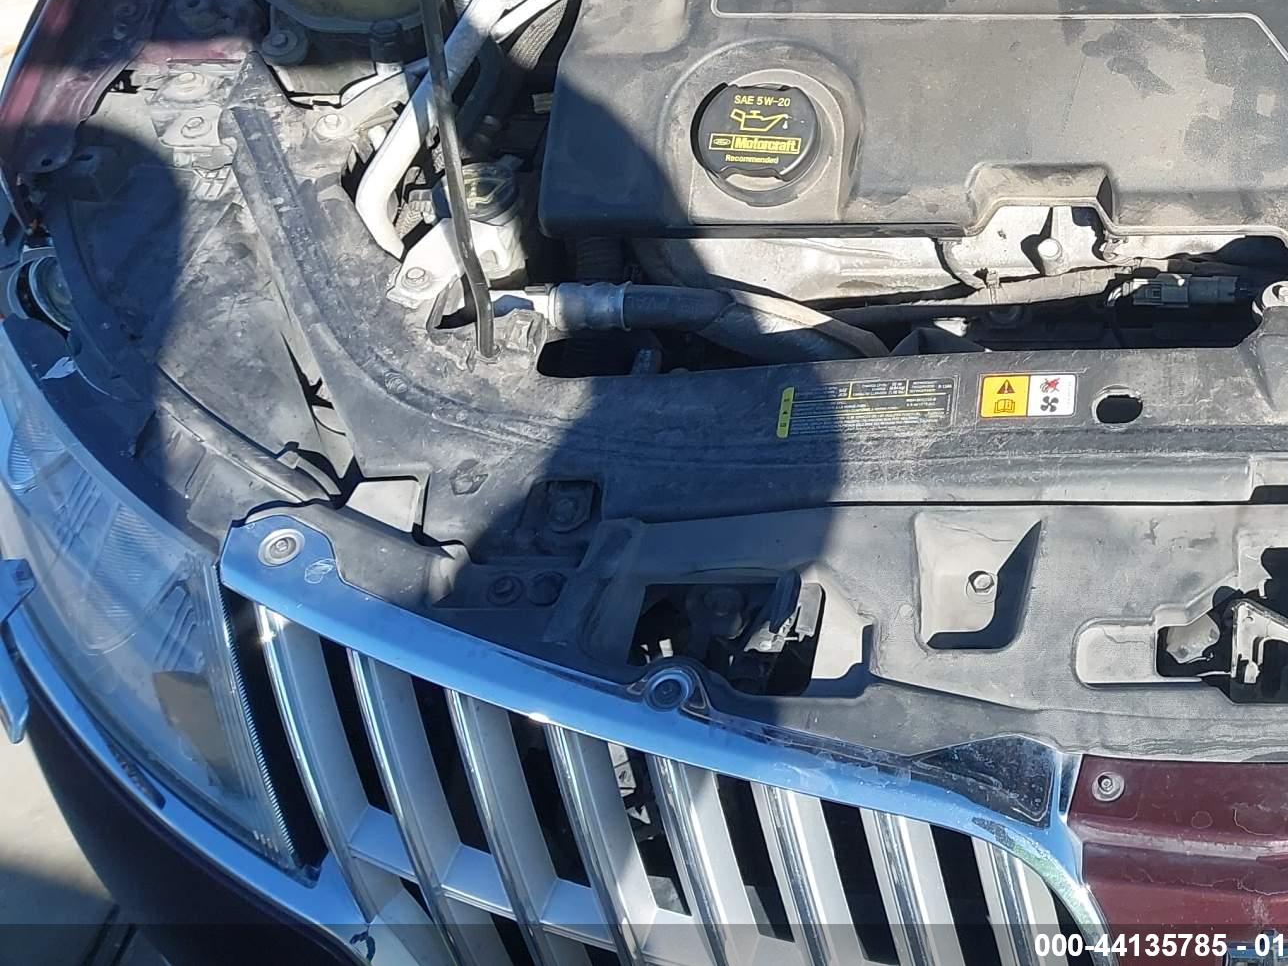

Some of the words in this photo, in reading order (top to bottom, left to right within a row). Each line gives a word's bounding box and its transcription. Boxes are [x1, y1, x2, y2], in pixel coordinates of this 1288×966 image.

[734, 95, 754, 105] SAE
[757, 96, 790, 107] 5W-20
[735, 137, 797, 152] Motorcraft
[725, 154, 779, 164] Recommended
